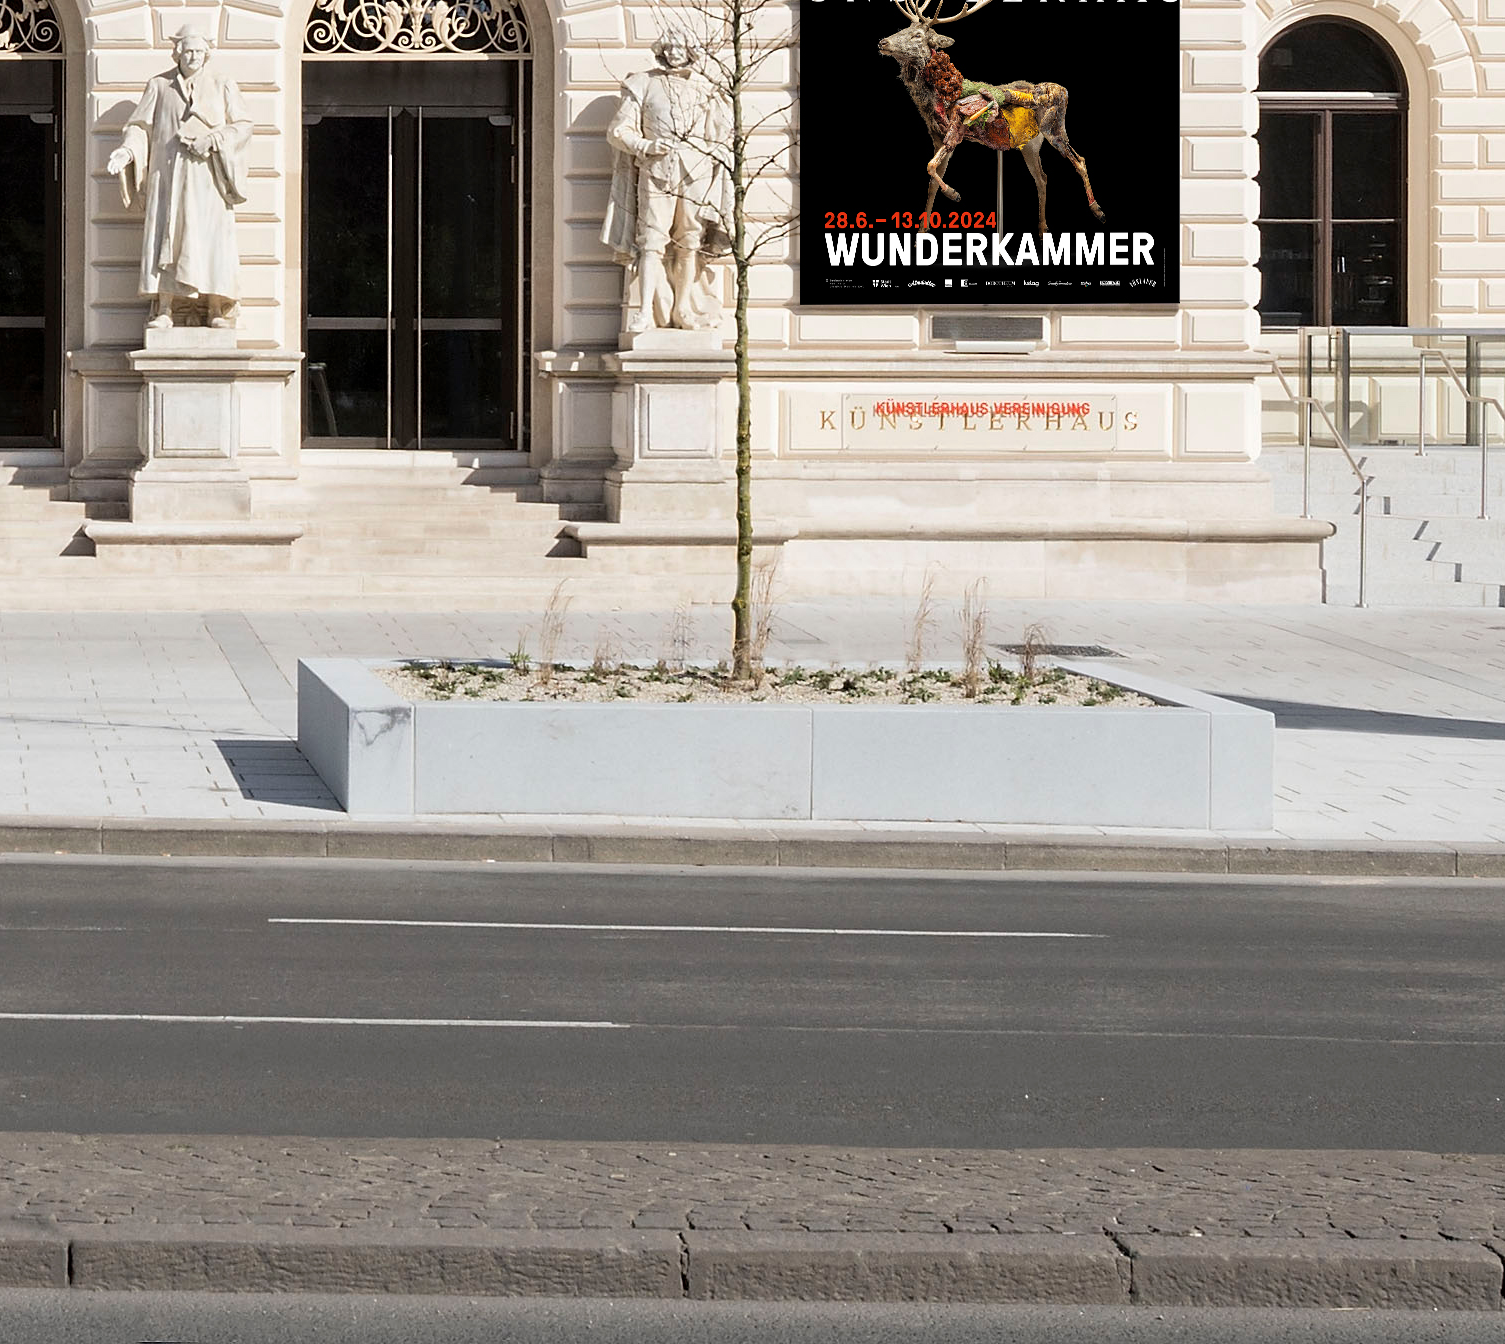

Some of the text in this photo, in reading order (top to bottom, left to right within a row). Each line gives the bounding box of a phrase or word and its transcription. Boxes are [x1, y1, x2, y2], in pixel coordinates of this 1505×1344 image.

[891, 211, 997, 229] 13.10.2024
[824, 232, 1155, 267] WUNDERKAMMER
[876, 398, 1089, 417] KÜNSTLERHAUS VEREINIGUNG
